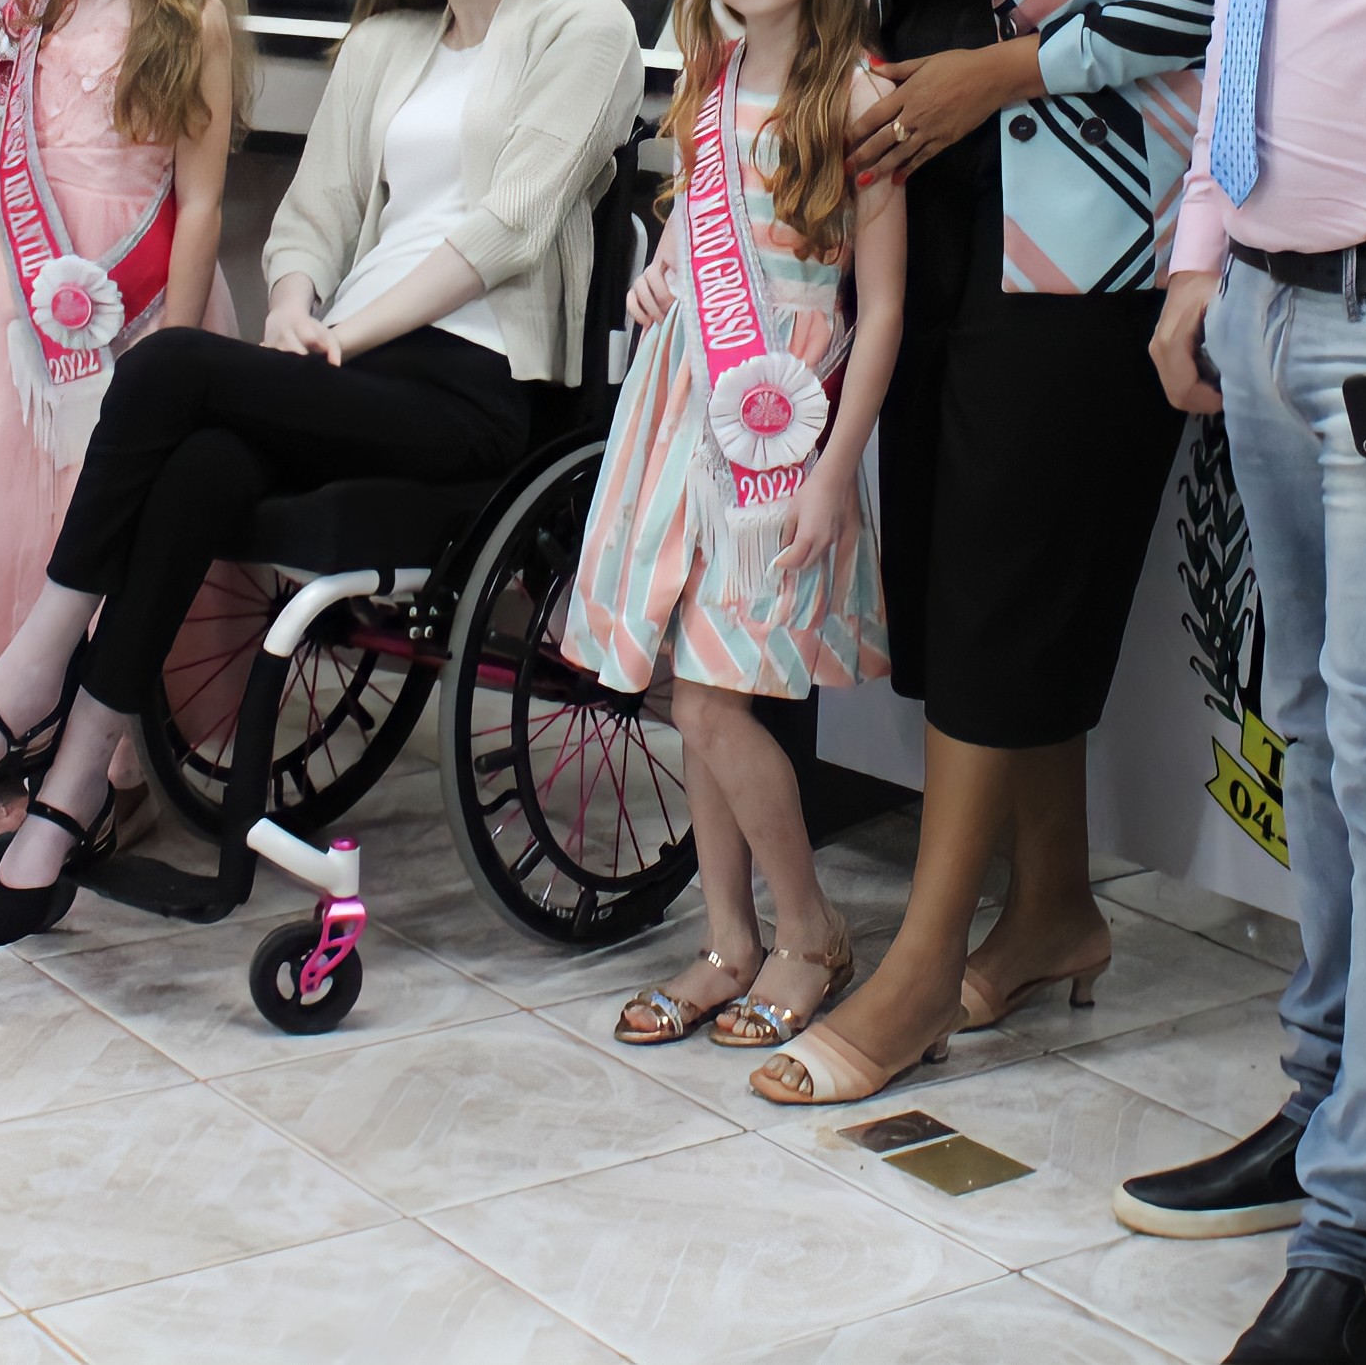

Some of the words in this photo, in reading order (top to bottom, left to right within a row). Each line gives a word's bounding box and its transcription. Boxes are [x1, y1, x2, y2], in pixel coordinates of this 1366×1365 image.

[691, 189, 736, 259] MATO
[697, 256, 757, 351] GROSSO
[48, 349, 100, 385] 2022
[740, 466, 803, 508] 2022
